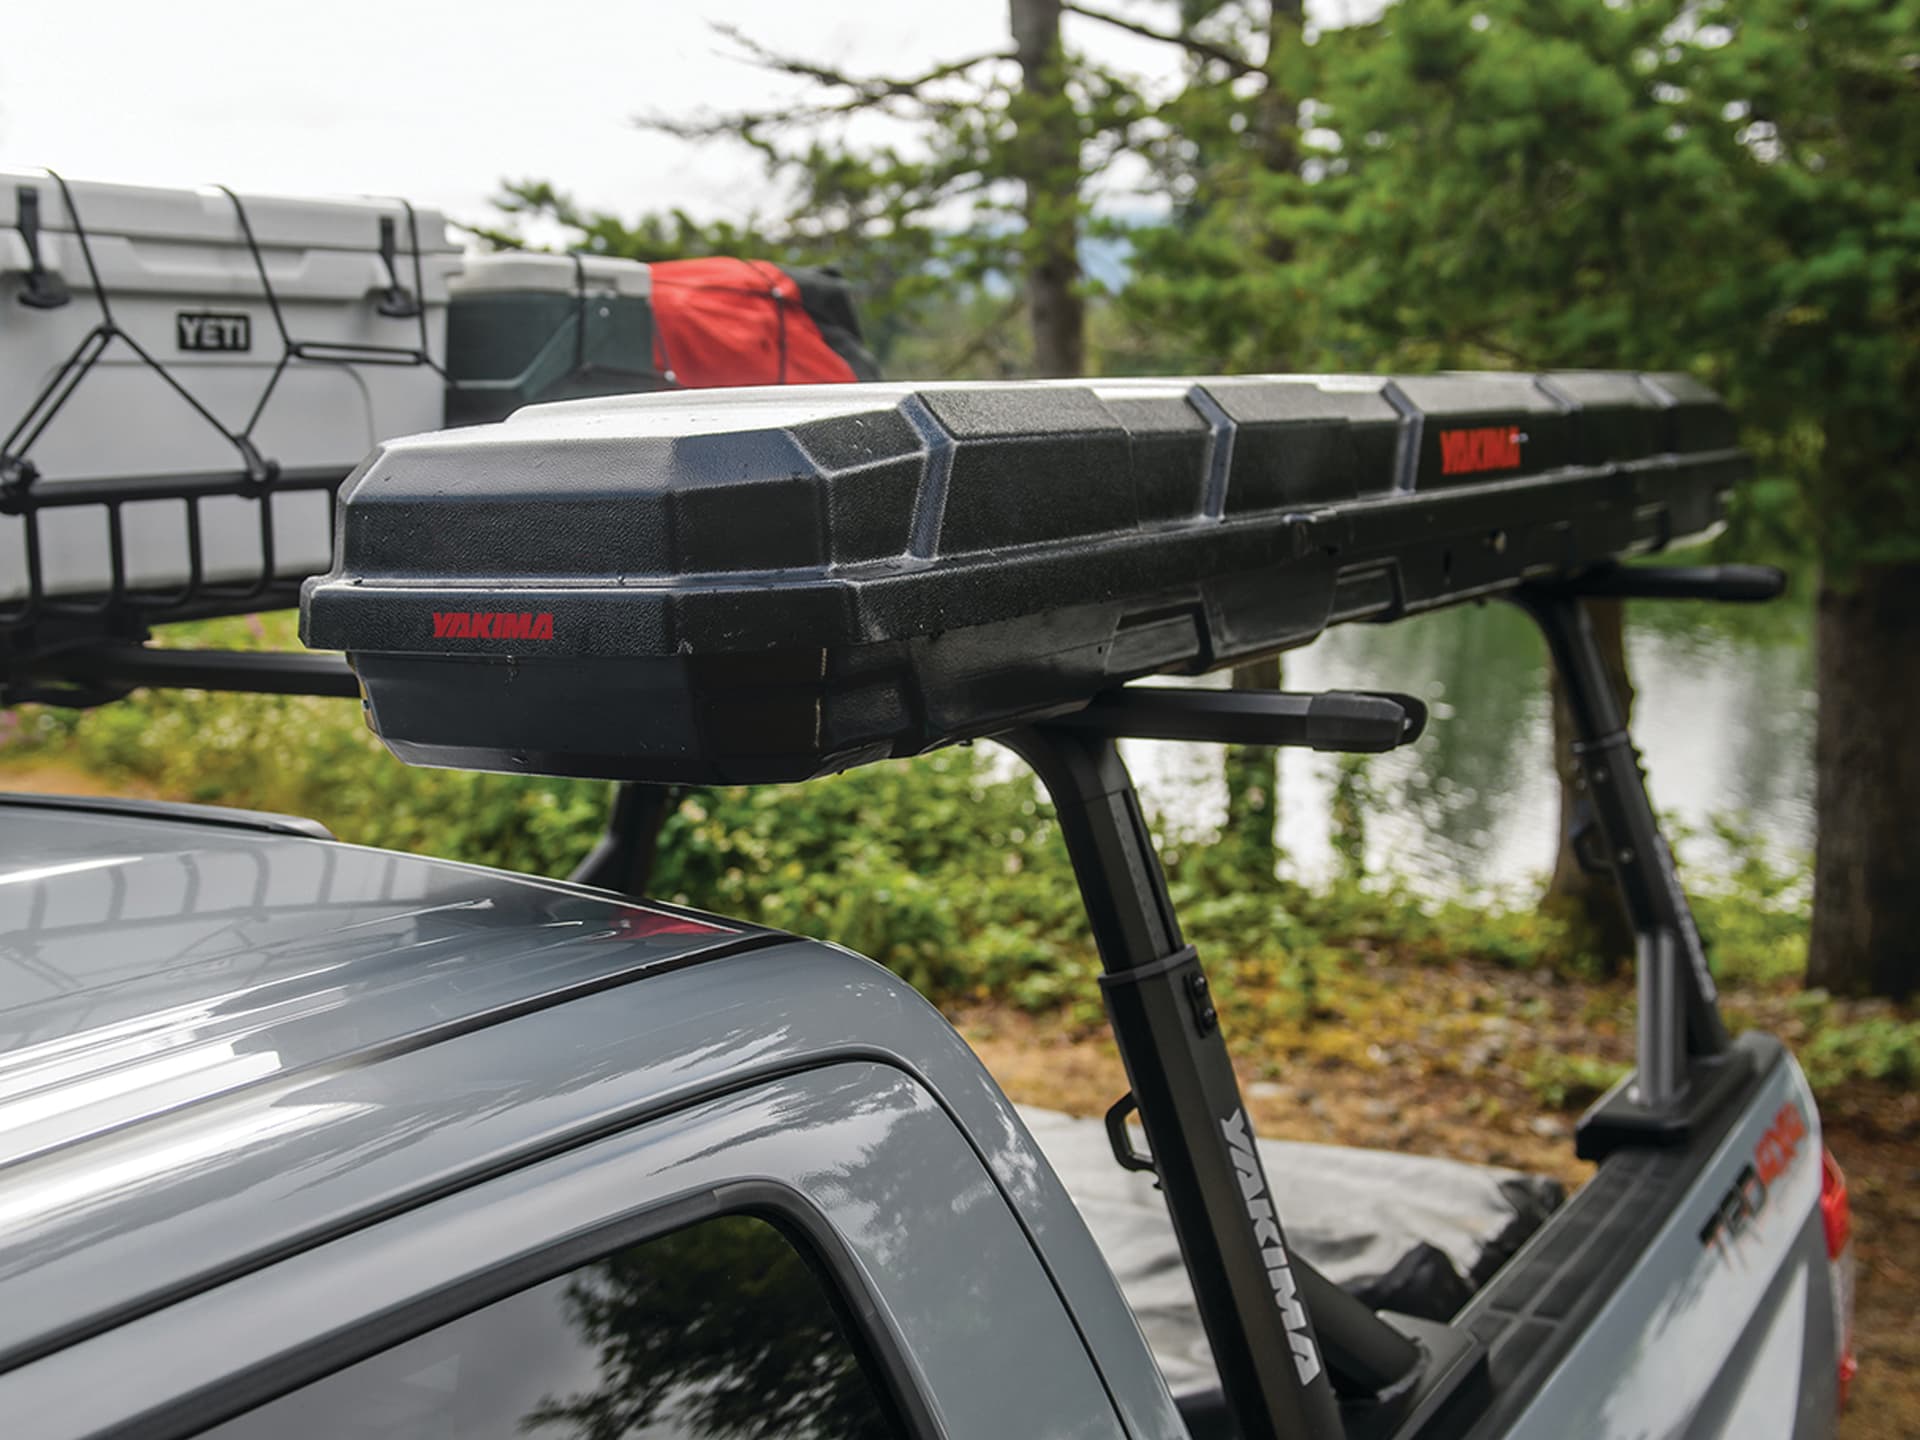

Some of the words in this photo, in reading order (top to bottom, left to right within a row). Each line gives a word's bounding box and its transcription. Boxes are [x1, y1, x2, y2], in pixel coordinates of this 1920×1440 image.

[181, 316, 246, 348] YETI
[1440, 426, 1520, 474] YAKIMA
[432, 612, 554, 640] YAKIMA
[1220, 1108, 1321, 1386] YAKIMA
